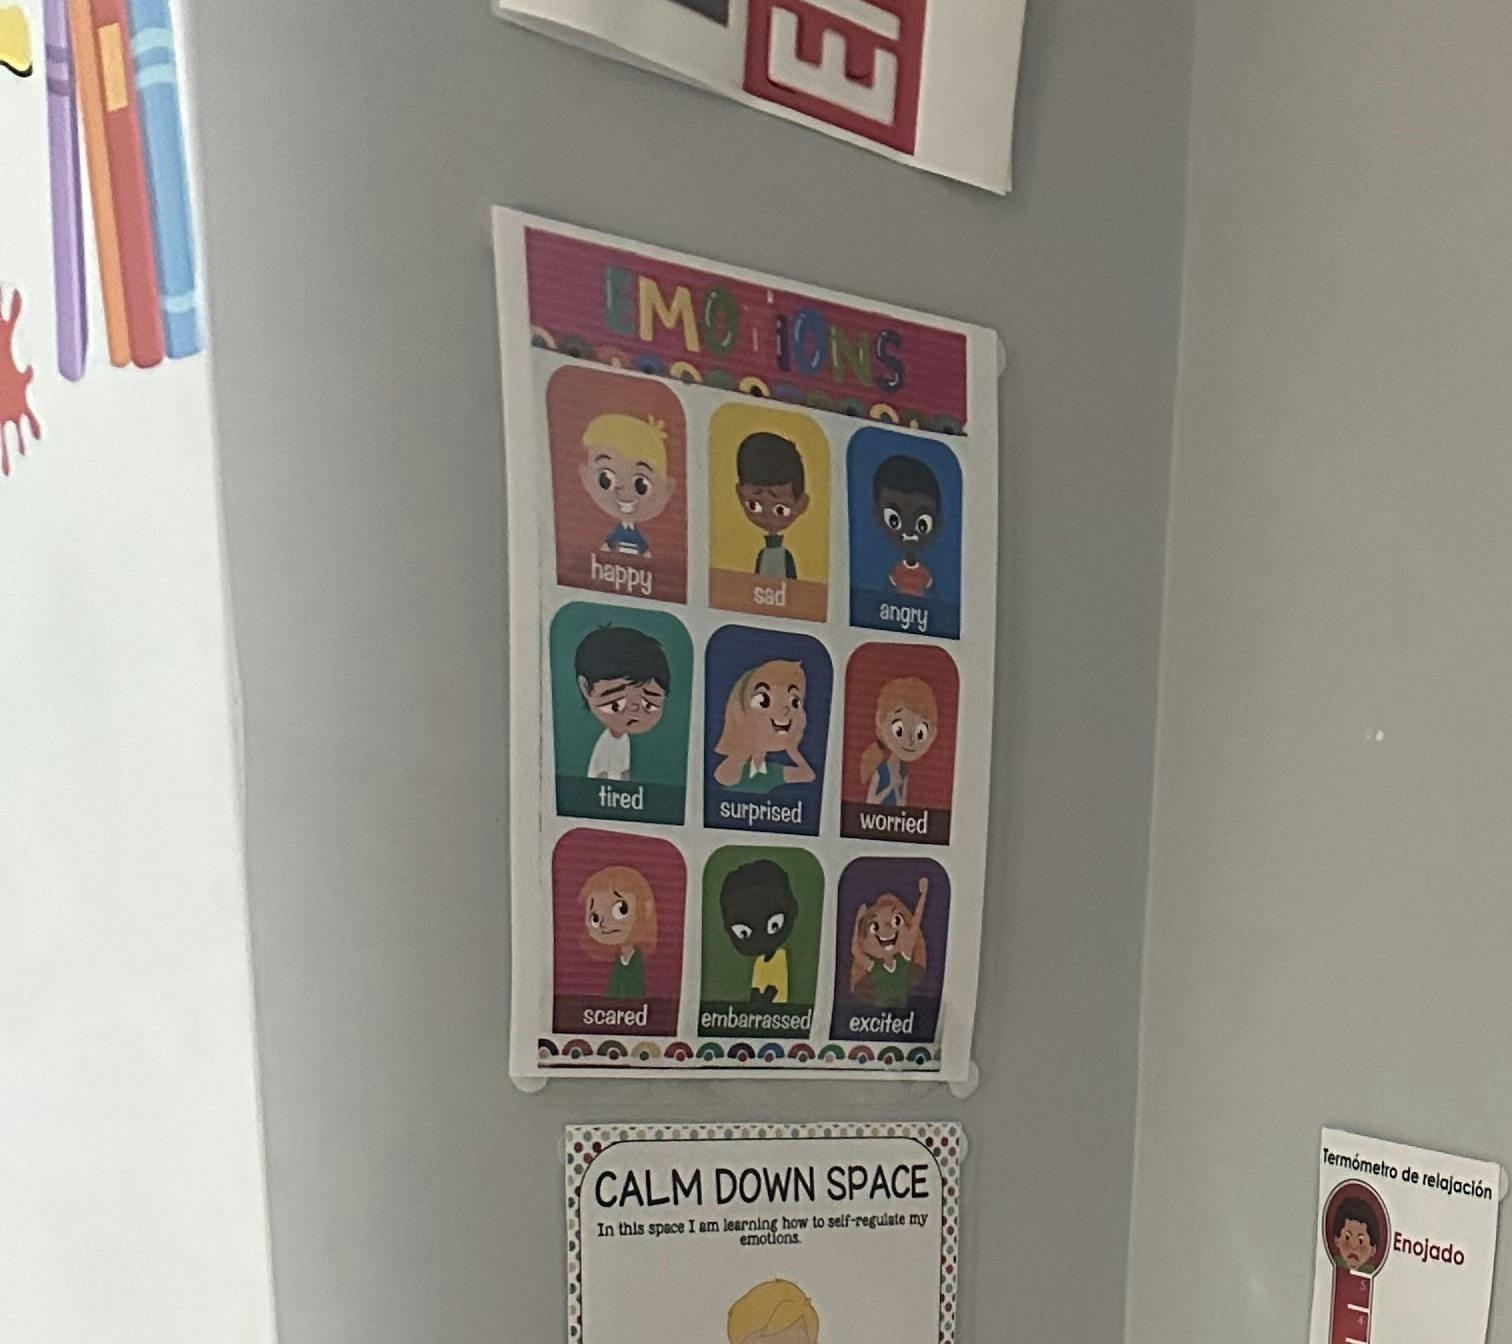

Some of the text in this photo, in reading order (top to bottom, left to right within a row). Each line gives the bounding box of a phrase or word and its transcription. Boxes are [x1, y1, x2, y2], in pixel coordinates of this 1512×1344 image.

[591, 553, 652, 594] happy
[754, 583, 786, 607] sad
[879, 602, 928, 631] angry
[599, 786, 643, 810] tired
[720, 800, 802, 825] surprised
[860, 811, 927, 834] worried
[583, 1005, 647, 1026] scared
[701, 1009, 812, 1031] embarrassed
[849, 1012, 913, 1034] excited
[595, 1164, 929, 1207] CALM DOWN SPACE
[1323, 1148, 1492, 1200] Termómetro de relajación
[598, 1214, 928, 1241] In this space I am learning how to self-regulate my
[740, 1231, 801, 1246] emotions.
[1394, 1232, 1464, 1265] Enojado
